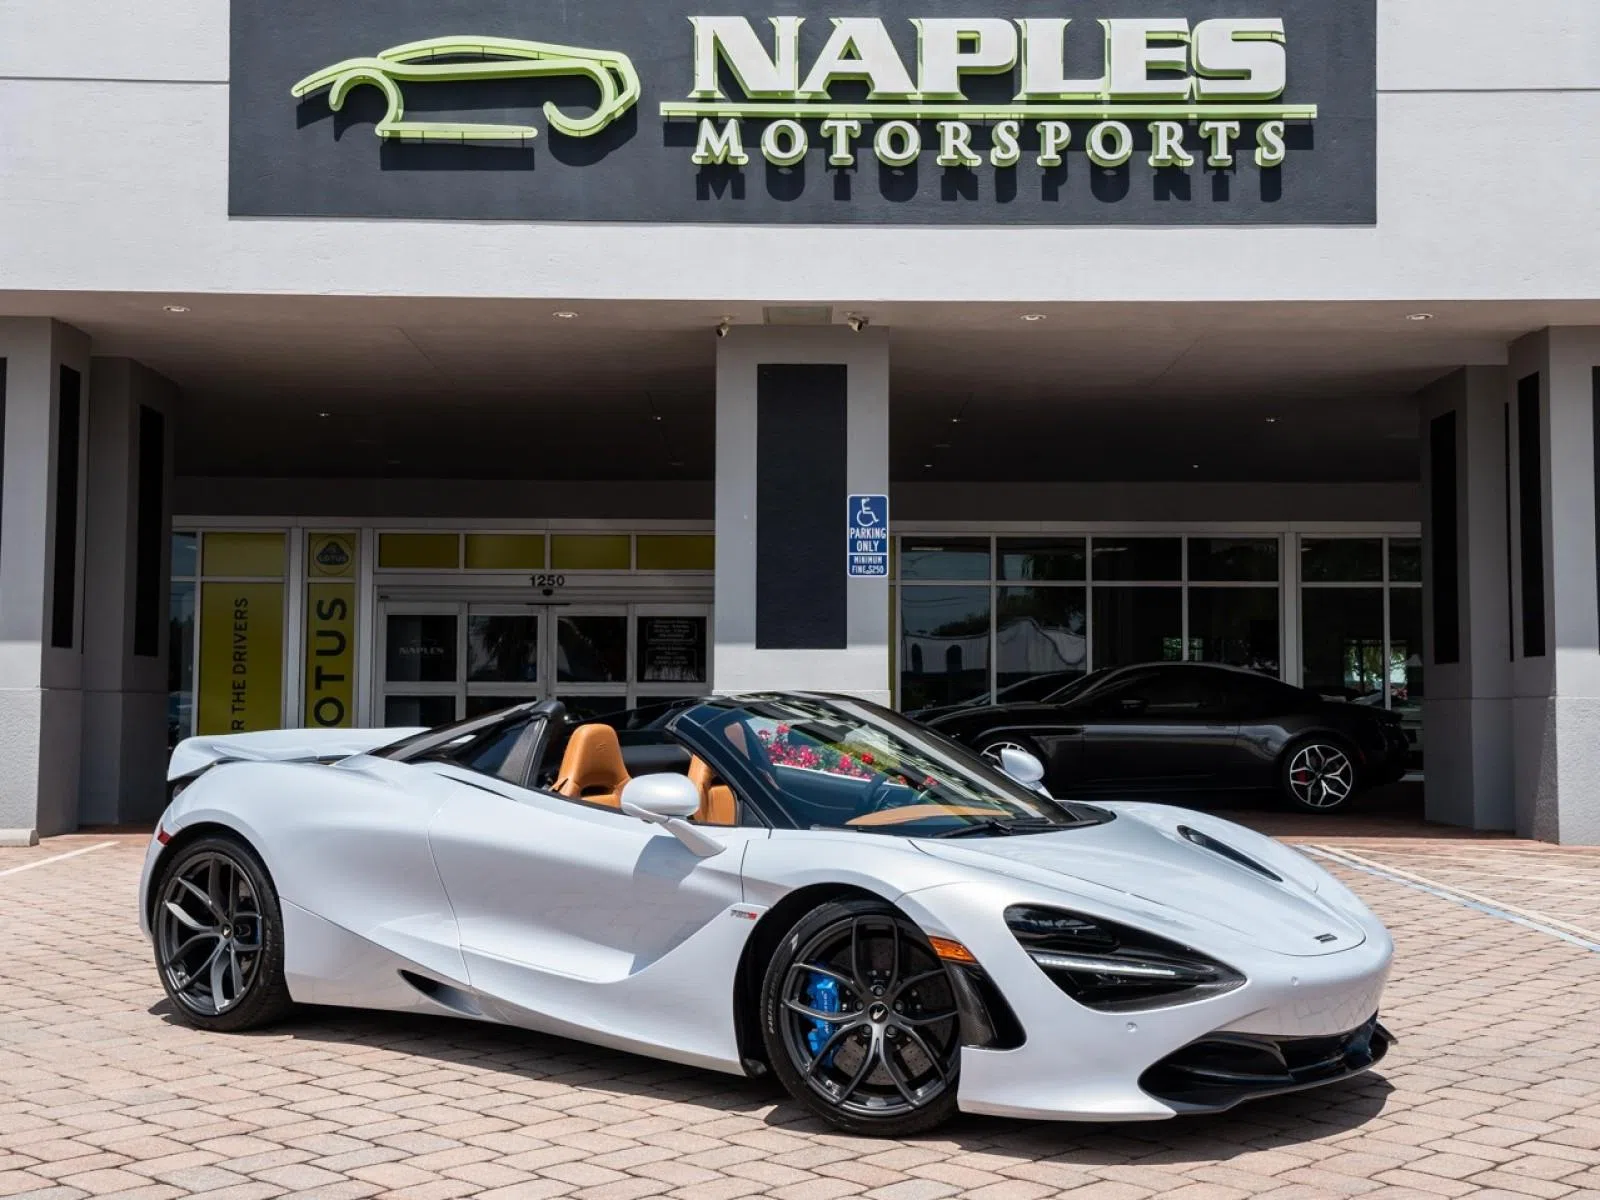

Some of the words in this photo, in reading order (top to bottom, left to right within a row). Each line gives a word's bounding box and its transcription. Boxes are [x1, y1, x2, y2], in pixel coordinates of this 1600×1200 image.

[687, 16, 1286, 100] NAPLES
[692, 119, 1286, 167] MOTORSPORTS
[850, 528, 886, 539] PARKING
[856, 541, 879, 552] ONLY
[852, 565, 866, 574] FINE
[854, 556, 883, 564] MINIMUM
[529, 575, 565, 587] 1250
[232, 598, 249, 674] DRIVERS
[313, 597, 348, 727] OTUS
[232, 679, 246, 715] THE
